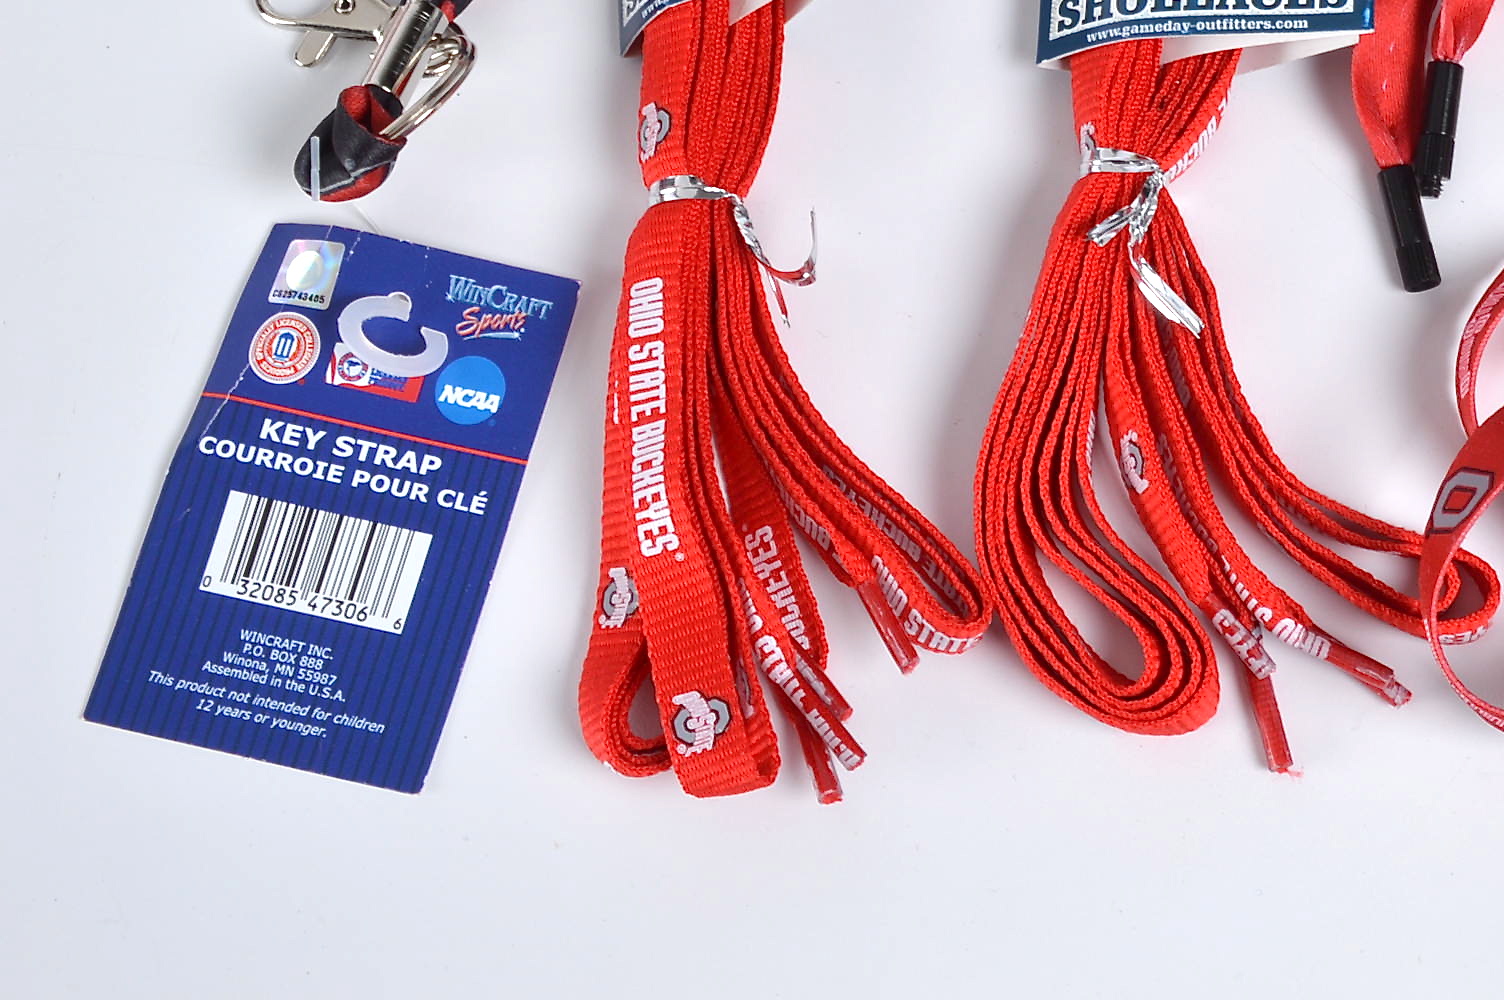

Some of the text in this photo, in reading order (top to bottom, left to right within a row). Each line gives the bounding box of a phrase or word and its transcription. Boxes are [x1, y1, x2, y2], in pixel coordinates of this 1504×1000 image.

[1087, 17, 1309, 43] www.gameday-outfitters.com
[438, 384, 501, 414] NCAA
[628, 276, 681, 558] OHIO STATE BUCKEYES
[259, 418, 442, 475] KEY STRAP
[199, 436, 488, 515] COURROIE POUR CLÉ
[202, 575, 402, 630] 0 32085 47306 6
[240, 629, 334, 660] WINCRAFT INC.
[243, 643, 323, 669] P.O. BOX 888
[201, 661, 346, 702] Assembled in the U.S.A.
[223, 651, 338, 686] Winona, MN 55987
[147, 670, 385, 734] This product not intended for children
[195, 698, 328, 738] 12 years or younger.
